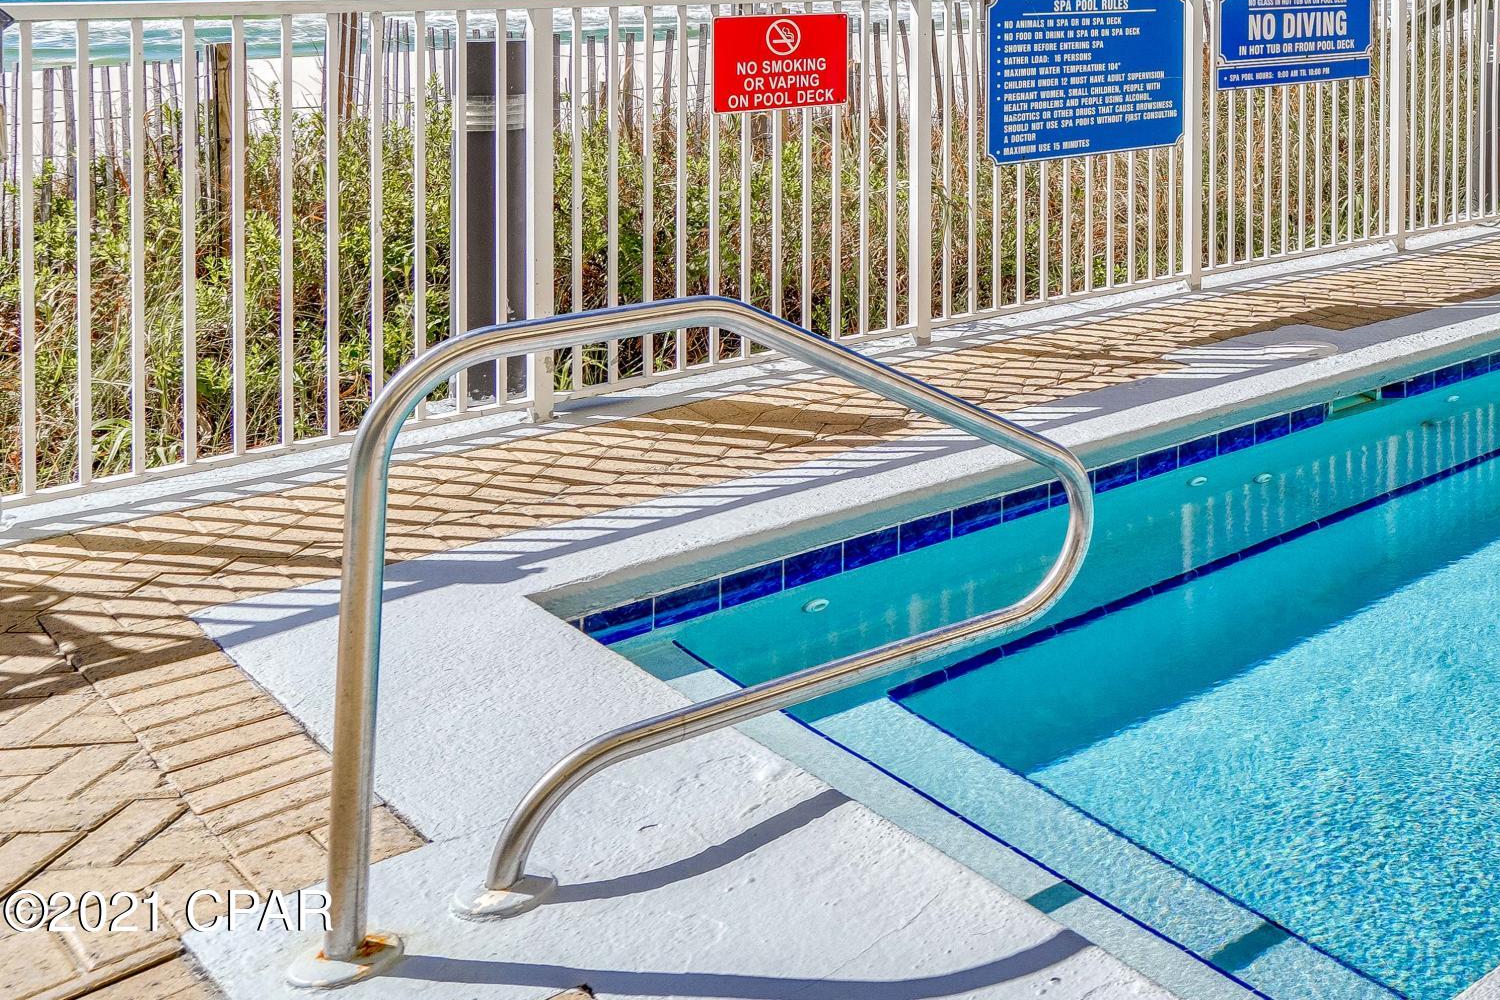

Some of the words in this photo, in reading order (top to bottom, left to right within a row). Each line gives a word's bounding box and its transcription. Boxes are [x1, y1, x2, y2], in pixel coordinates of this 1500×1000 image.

[1054, 0, 1071, 12] SPA
[1076, 0, 1098, 11] POOL
[1102, 0, 1128, 10] RULES
[1016, 20, 1044, 28] ANIMALS
[1047, 19, 1054, 27] IN
[1056, 19, 1068, 27] SPA
[1071, 18, 1079, 26] OR
[1082, 18, 1090, 26] ON
[1092, 17, 1104, 25] SPA
[1249, 13, 1275, 40] NO
[1283, 10, 1347, 38] DIVING
[1004, 33, 1013, 41] NO
[1016, 32, 1032, 40] FOOD
[1046, 31, 1064, 39] DRINK
[1068, 30, 1074, 38] IN
[1077, 30, 1088, 38] SPA
[1091, 29, 1098, 37] OR
[1112, 28, 1123, 36] SPA
[1004, 44, 1031, 53] SHOWER
[1034, 43, 1057, 51] BEFORE
[1060, 42, 1089, 50] ENTERING
[1239, 46, 1247, 56] IN
[1249, 45, 1264, 55] HOT
[1266, 44, 1280, 54] TUB
[1282, 43, 1293, 53] OR
[1295, 42, 1315, 52] FROM
[1317, 41, 1335, 50] POOL
[1337, 39, 1355, 49] DECK
[737, 61, 758, 75] NO
[762, 58, 826, 74] SMOKING
[1004, 57, 1028, 65] BATHER
[1031, 55, 1049, 63] LOAD:
[1064, 53, 1092, 62] PERSONS
[1004, 68, 1036, 77] MAXIMUM
[1039, 66, 1060, 75] WATER
[1063, 64, 1106, 73] TEMPERATURE
[1256, 72, 1274, 80] HOURS:
[744, 77, 764, 91] OR
[769, 74, 819, 89] VAPING
[1004, 80, 1035, 89] CHILDREN
[1038, 78, 1059, 87] UNDER
[1061, 78, 1067, 86] 12
[1090, 75, 1104, 83] HAVE
[1108, 73, 1125, 82] ADULT
[1128, 71, 1164, 81] SUPERVISION
[728, 95, 748, 108] ON
[754, 92, 792, 106] POOL
[798, 88, 834, 104] DECK
[1004, 91, 1038, 101] PREGNANT
[1040, 90, 1066, 98] WOMEN,
[1068, 88, 1088, 96] SMALL
[1091, 85, 1120, 94] CHILDREN,
[1123, 84, 1144, 92] PEOPLE
[1146, 82, 1160, 90] WITH
[1004, 103, 1028, 112] HEALTH
[1030, 100, 1063, 109] PROBLEMS
[1081, 96, 1102, 105] PEOPLE
[1105, 95, 1123, 103] USING
[1004, 112, 1040, 122] NARCOTICS
[1042, 111, 1051, 119] OR
[1054, 109, 1073, 118] OTHER
[1076, 107, 1096, 116] DRUGS
[1115, 104, 1134, 112] CAUSE
[1136, 100, 1172, 110] DROWSINESS
[1004, 123, 1028, 133] SHOULD
[1031, 122, 1044, 130] NOT
[1046, 121, 1058, 129] USE
[1076, 118, 1094, 126] POOLS
[1097, 114, 1123, 124] WITHOUT
[1125, 113, 1141, 122] FIRST
[1143, 110, 1177, 120] CONSULTING
[1011, 133, 1036, 142] DOCTOR
[1004, 145, 1036, 155] MAXIMUM
[1039, 144, 1051, 152] USE
[1063, 140, 1090, 149] MINUTES
